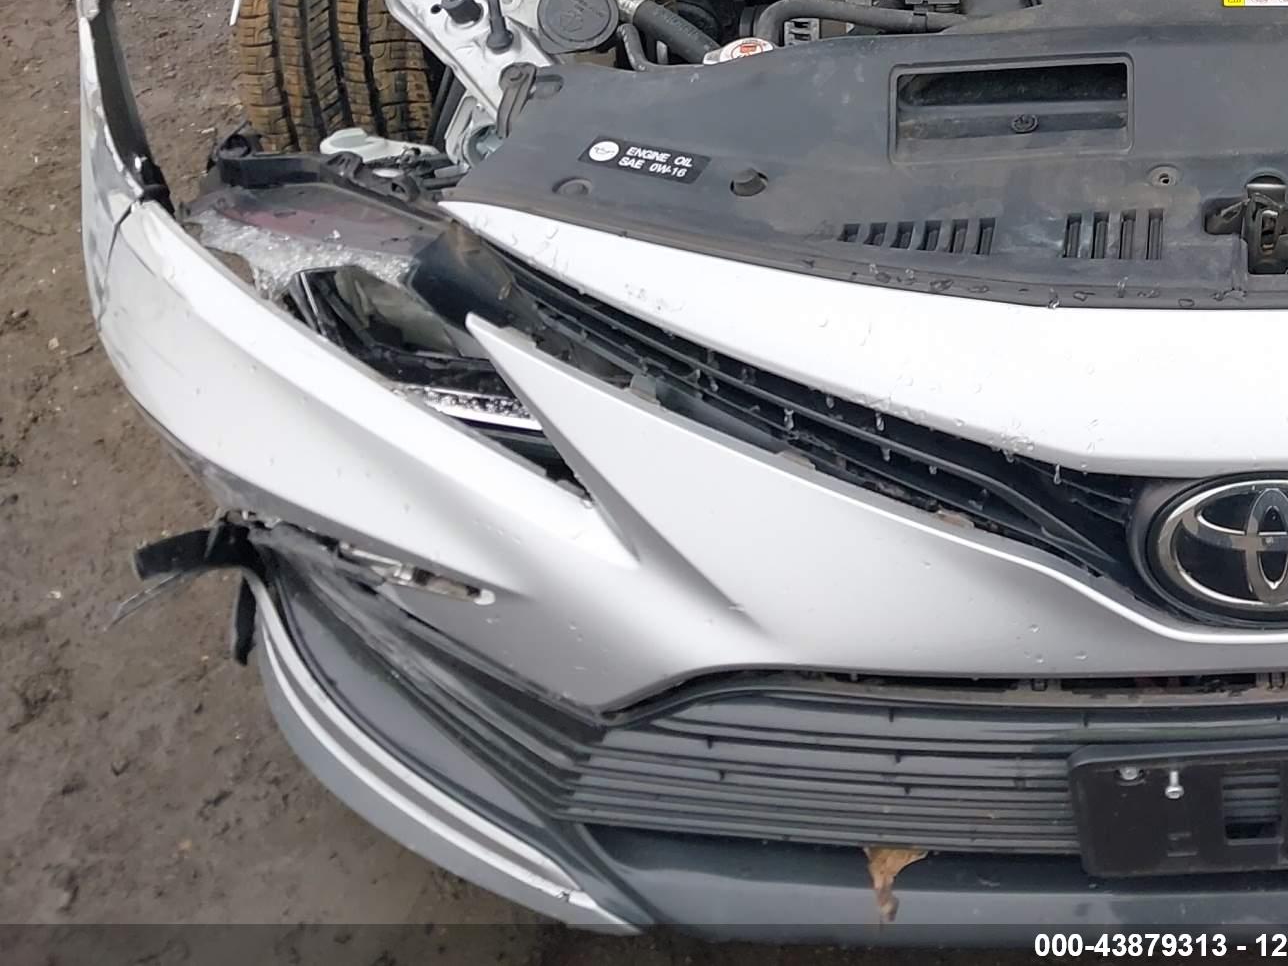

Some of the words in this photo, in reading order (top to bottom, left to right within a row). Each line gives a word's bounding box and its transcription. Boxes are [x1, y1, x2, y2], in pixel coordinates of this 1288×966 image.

[626, 147, 670, 162] ENGINE
[675, 156, 692, 167] OIL
[619, 158, 645, 169] SAE
[650, 163, 687, 177] 0W-16
